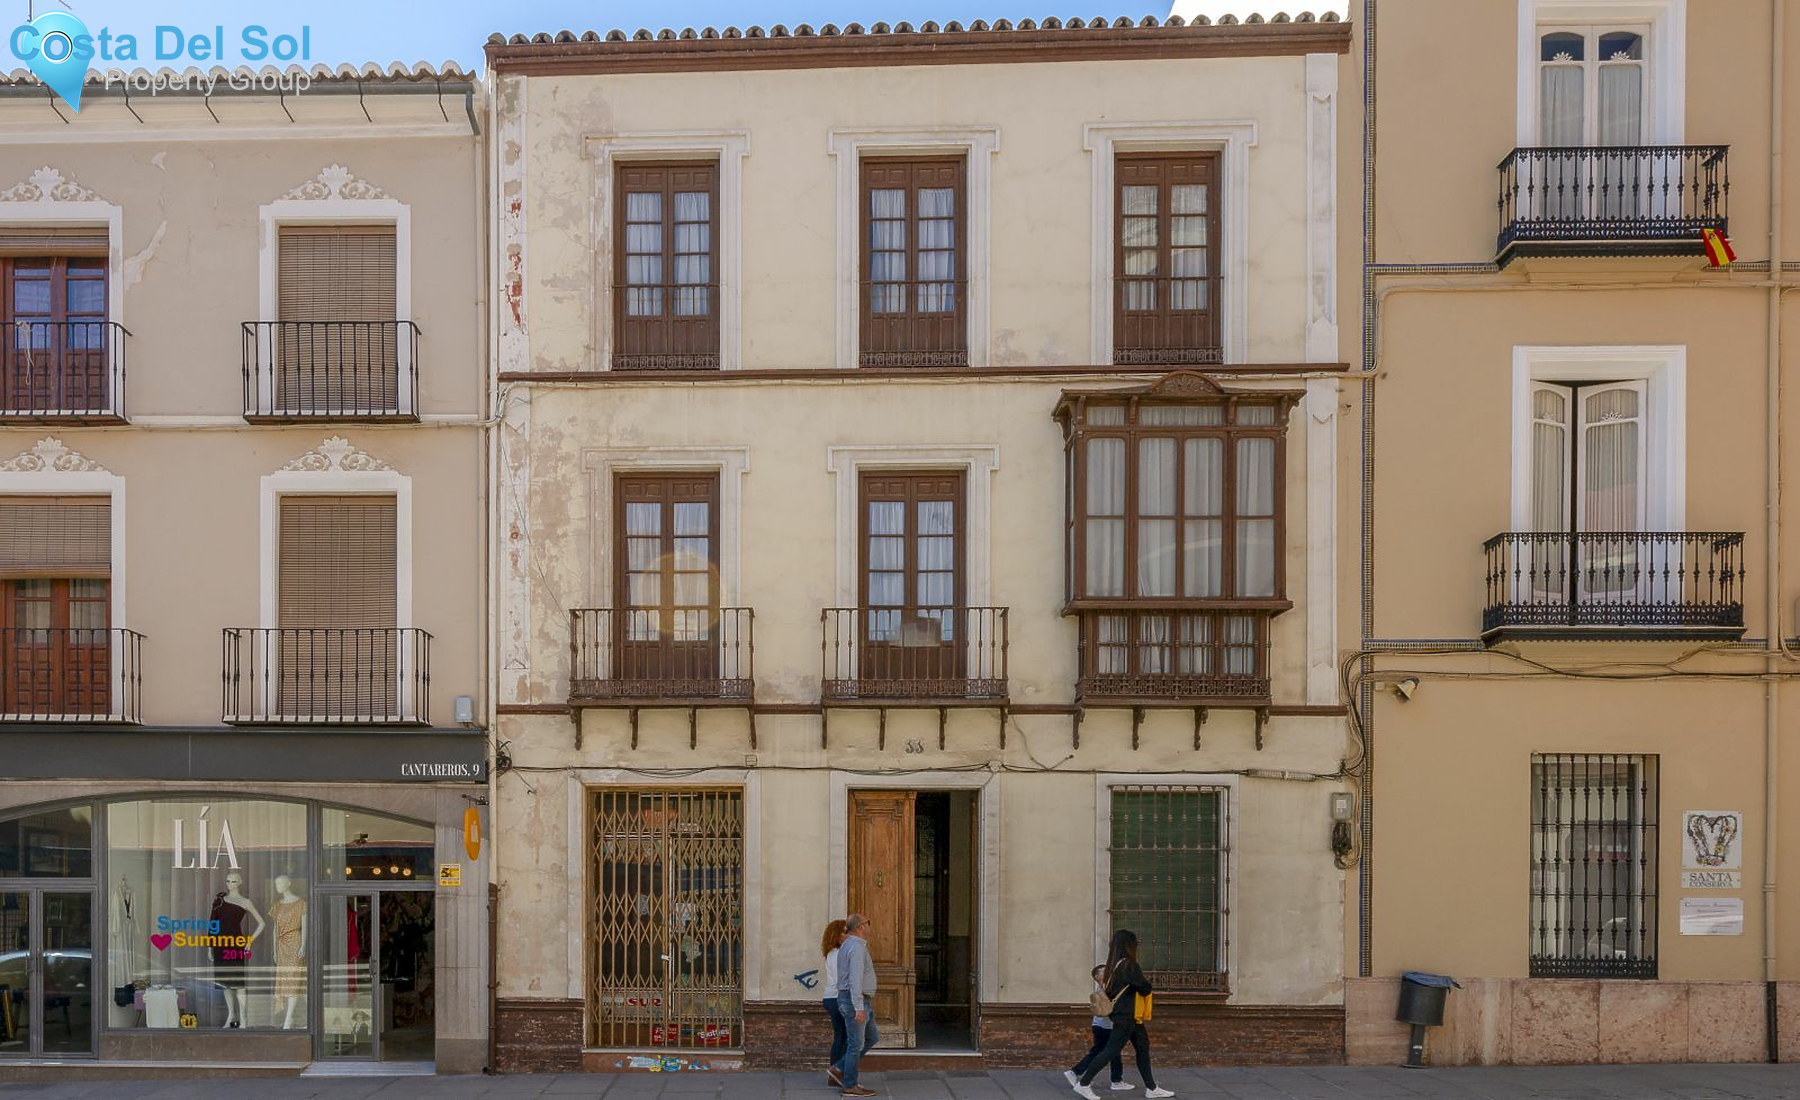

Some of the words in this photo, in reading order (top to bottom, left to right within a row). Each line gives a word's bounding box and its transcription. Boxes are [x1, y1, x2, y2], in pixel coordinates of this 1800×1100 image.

[401, 763, 471, 777] CANTAREROS,
[472, 763, 480, 776] 9
[171, 805, 242, 869] LÍA
[1689, 872, 1733, 882] SANTA
[157, 915, 221, 935] Spring
[173, 931, 253, 947] Summer
[222, 949, 252, 960] 2019
